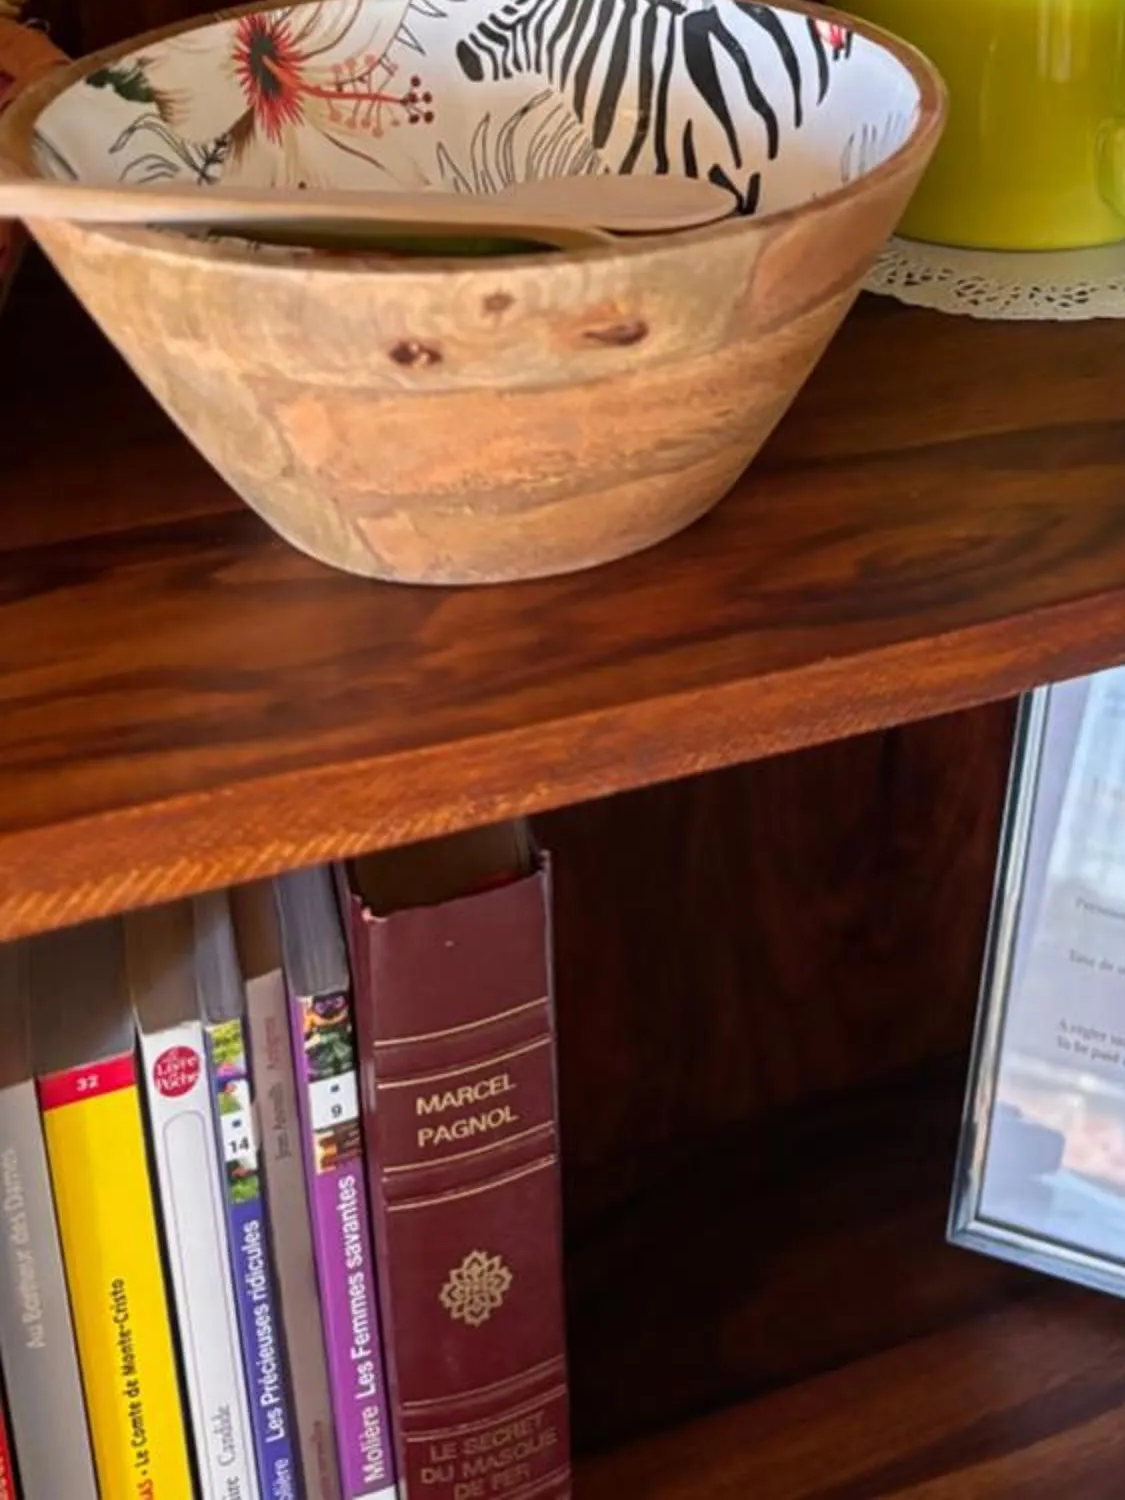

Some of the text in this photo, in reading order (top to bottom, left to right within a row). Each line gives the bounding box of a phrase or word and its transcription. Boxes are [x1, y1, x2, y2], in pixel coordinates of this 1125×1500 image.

[76, 1073, 99, 1092] 32
[415, 1072, 517, 1116] MARCEL
[331, 1104, 343, 1118] 9
[417, 1105, 520, 1149] PAGNOL
[229, 1137, 250, 1153] 14
[241, 1218, 269, 1302] ridicules
[109, 1277, 139, 1376] Monte-Cristo
[335, 1173, 386, 1484] Molière Les Femmes savantes
[252, 1303, 281, 1408] Précieuses
[123, 1379, 141, 1398] de
[128, 1402, 148, 1448] Comte
[211, 1403, 236, 1467] Candide
[264, 1406, 286, 1443] Les
[430, 1408, 546, 1463] LE SECRET
[134, 1448, 150, 1469] Le
[420, 1426, 559, 1485] DU MASQUE
[492, 1462, 532, 1491] FER
